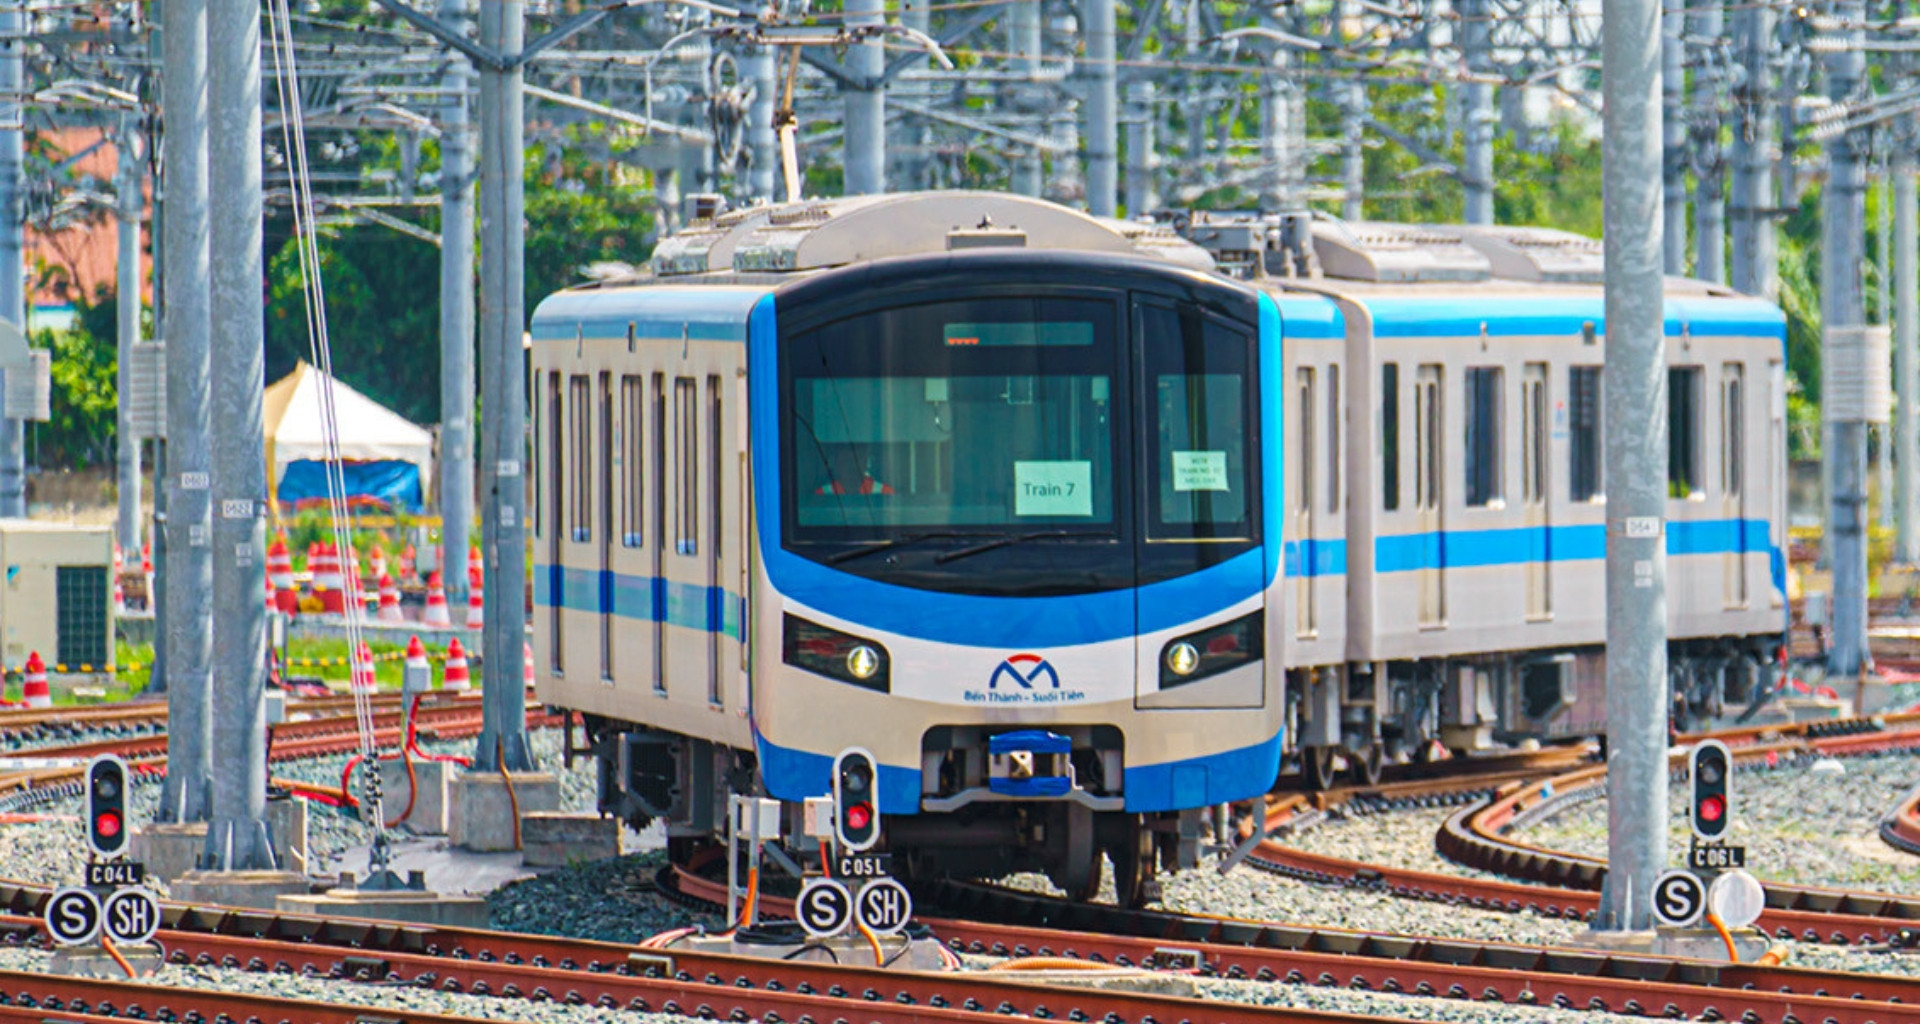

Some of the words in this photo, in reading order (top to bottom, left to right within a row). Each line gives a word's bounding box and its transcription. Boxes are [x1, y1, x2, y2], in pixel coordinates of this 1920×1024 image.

[1023, 482, 1062, 497] Train
[1065, 482, 1076, 497] 7
[92, 865, 137, 883] C04L
[841, 857, 886, 876] C05L
[1695, 848, 1739, 867] C06L
[60, 897, 87, 935] S
[114, 897, 148, 935] SH
[811, 889, 838, 927] S
[867, 888, 900, 926] SH
[1664, 880, 1691, 917] S
